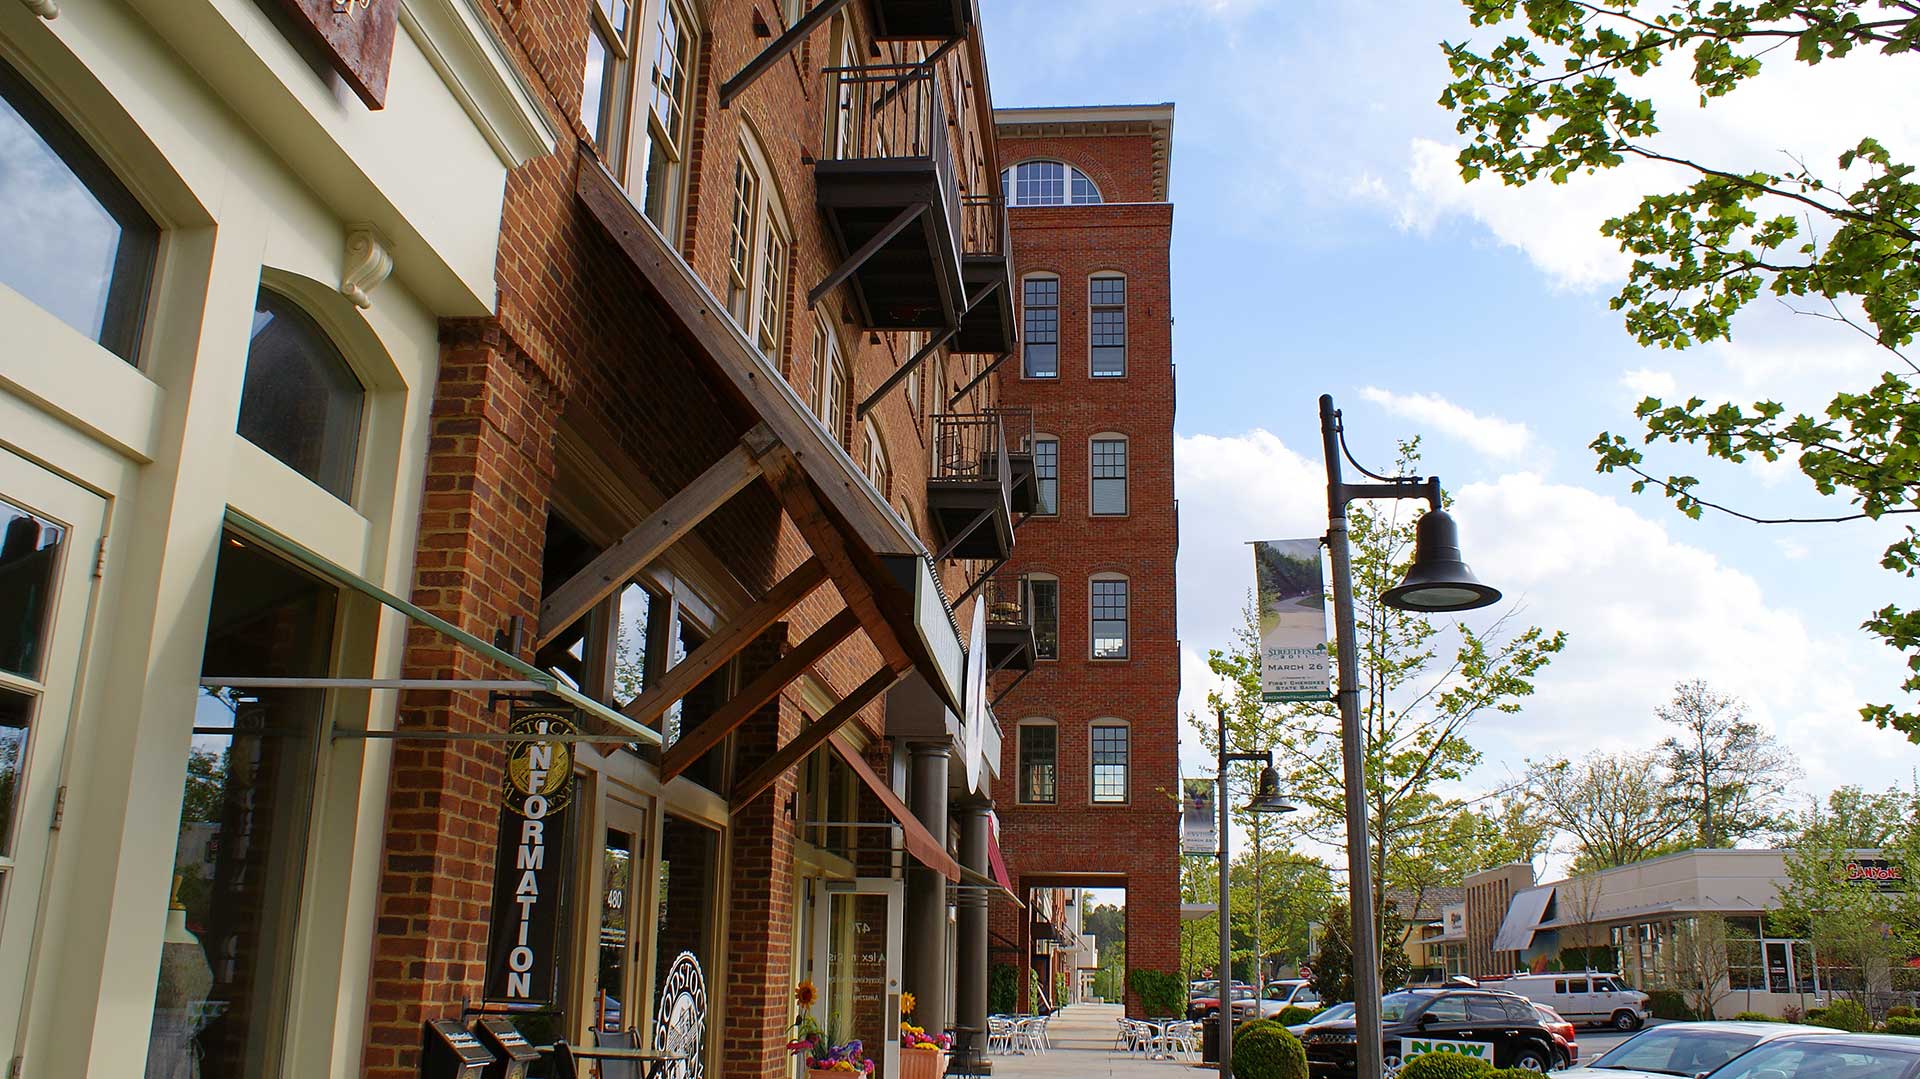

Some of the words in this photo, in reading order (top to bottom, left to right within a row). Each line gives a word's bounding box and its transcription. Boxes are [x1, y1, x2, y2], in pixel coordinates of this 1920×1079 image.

[506, 721, 552, 998] INFORMATION
[607, 889, 622, 909] 480
[1411, 1040, 1486, 1057] NOW
